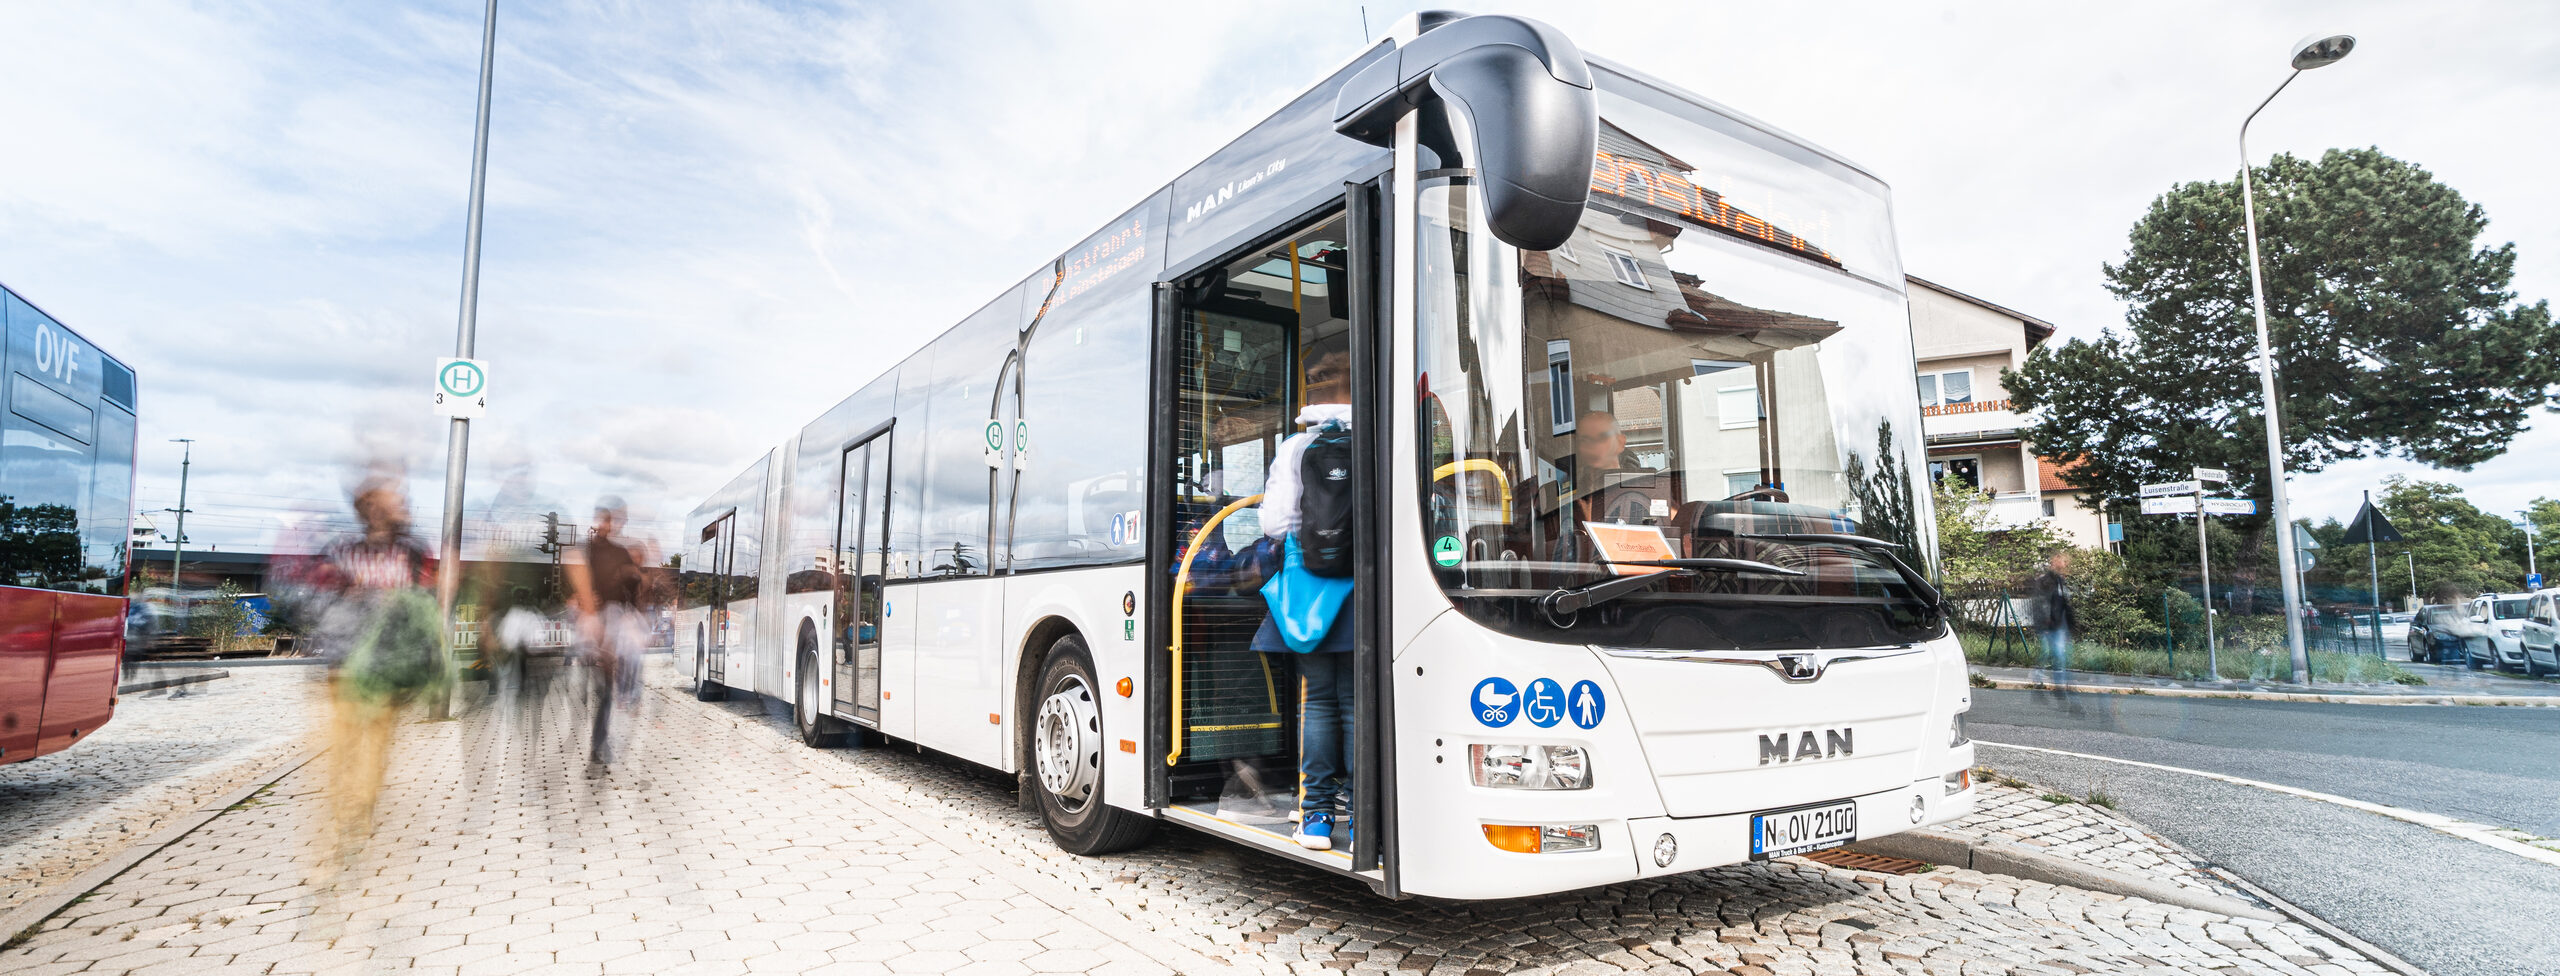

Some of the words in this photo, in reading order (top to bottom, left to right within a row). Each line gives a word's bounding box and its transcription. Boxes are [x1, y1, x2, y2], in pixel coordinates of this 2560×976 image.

[1187, 181, 1234, 223] MAN
[1238, 171, 1264, 193] Lion's
[1267, 158, 1286, 176] City
[35, 323, 79, 385] OVF
[453, 368, 471, 390] H
[436, 392, 443, 405] 3
[478, 397, 485, 408] 4
[2201, 470, 2223, 479] Feldstraße
[2144, 484, 2189, 495] Luisenstraße
[1443, 537, 1452, 551] 4
[1759, 727, 1853, 766] MAN
[1765, 818, 1777, 847] N
[1789, 813, 1811, 843] OV
[1815, 807, 1853, 839] 2100
[1755, 839, 1760, 848] D
[1768, 849, 1781, 859] MAN
[1781, 848, 1793, 857] Truck
